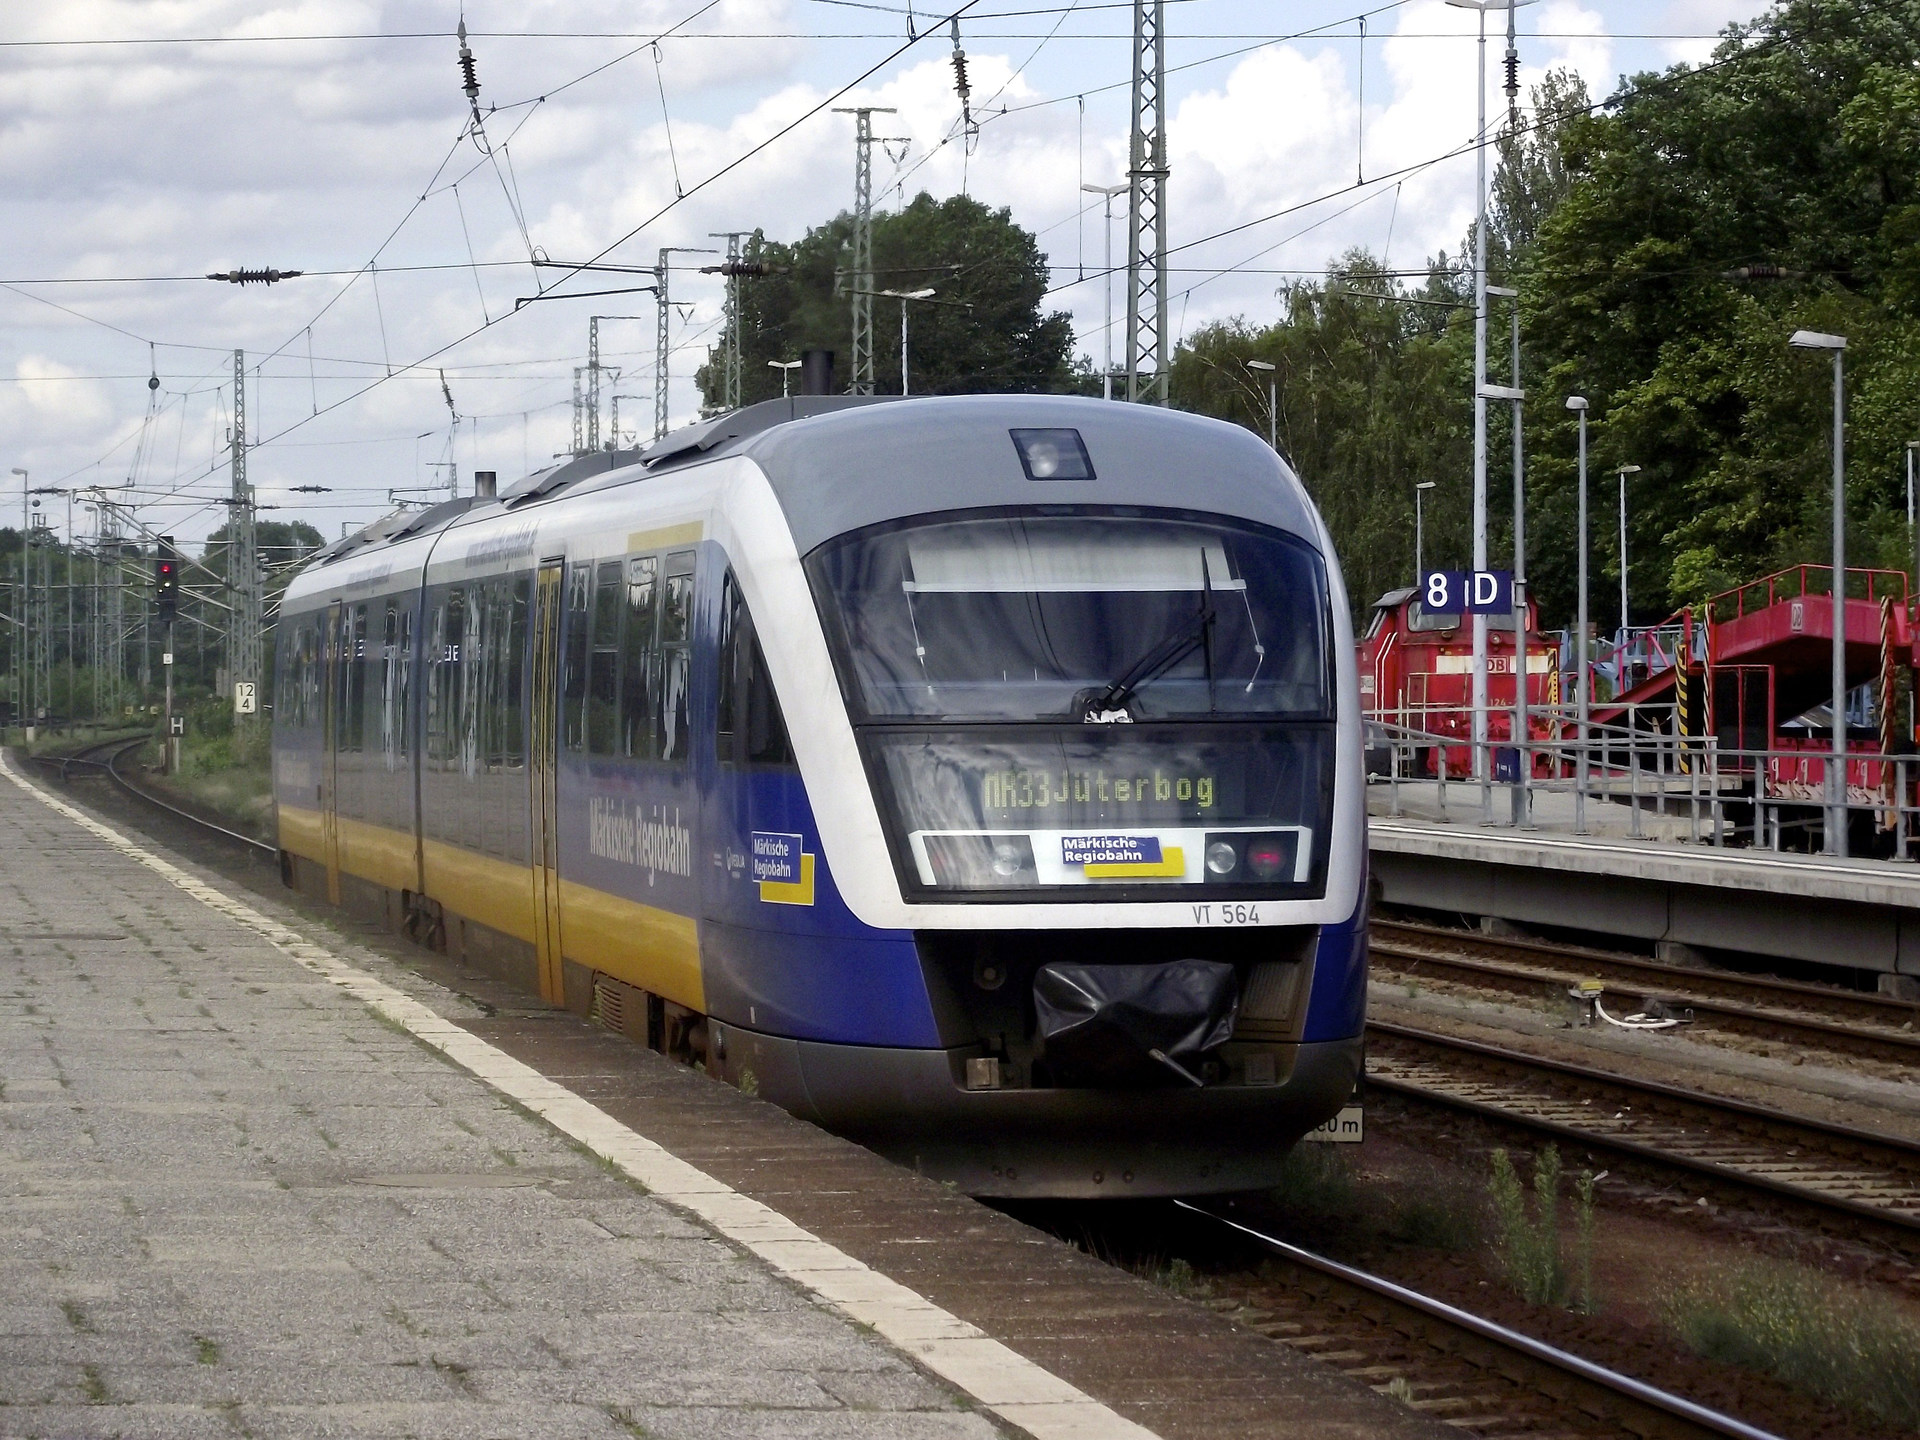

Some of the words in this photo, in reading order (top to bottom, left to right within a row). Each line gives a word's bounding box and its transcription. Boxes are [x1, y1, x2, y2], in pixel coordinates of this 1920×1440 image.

[1427, 572, 1448, 608] 8
[1474, 573, 1498, 605] D
[238, 684, 254, 697] 12
[241, 698, 251, 710] 4
[171, 717, 184, 734] H
[1053, 769, 1214, 808] Jüterbog
[589, 797, 634, 865] Märkische
[636, 804, 690, 888] Regiobahn
[753, 838, 789, 857] Märkische
[1063, 837, 1137, 849] Märkische
[1064, 850, 1142, 864] Regiobahn
[753, 858, 791, 880] Regiobahn
[1192, 905, 1211, 924] VT
[1222, 904, 1259, 924] 564
[1342, 1121, 1358, 1133] m
